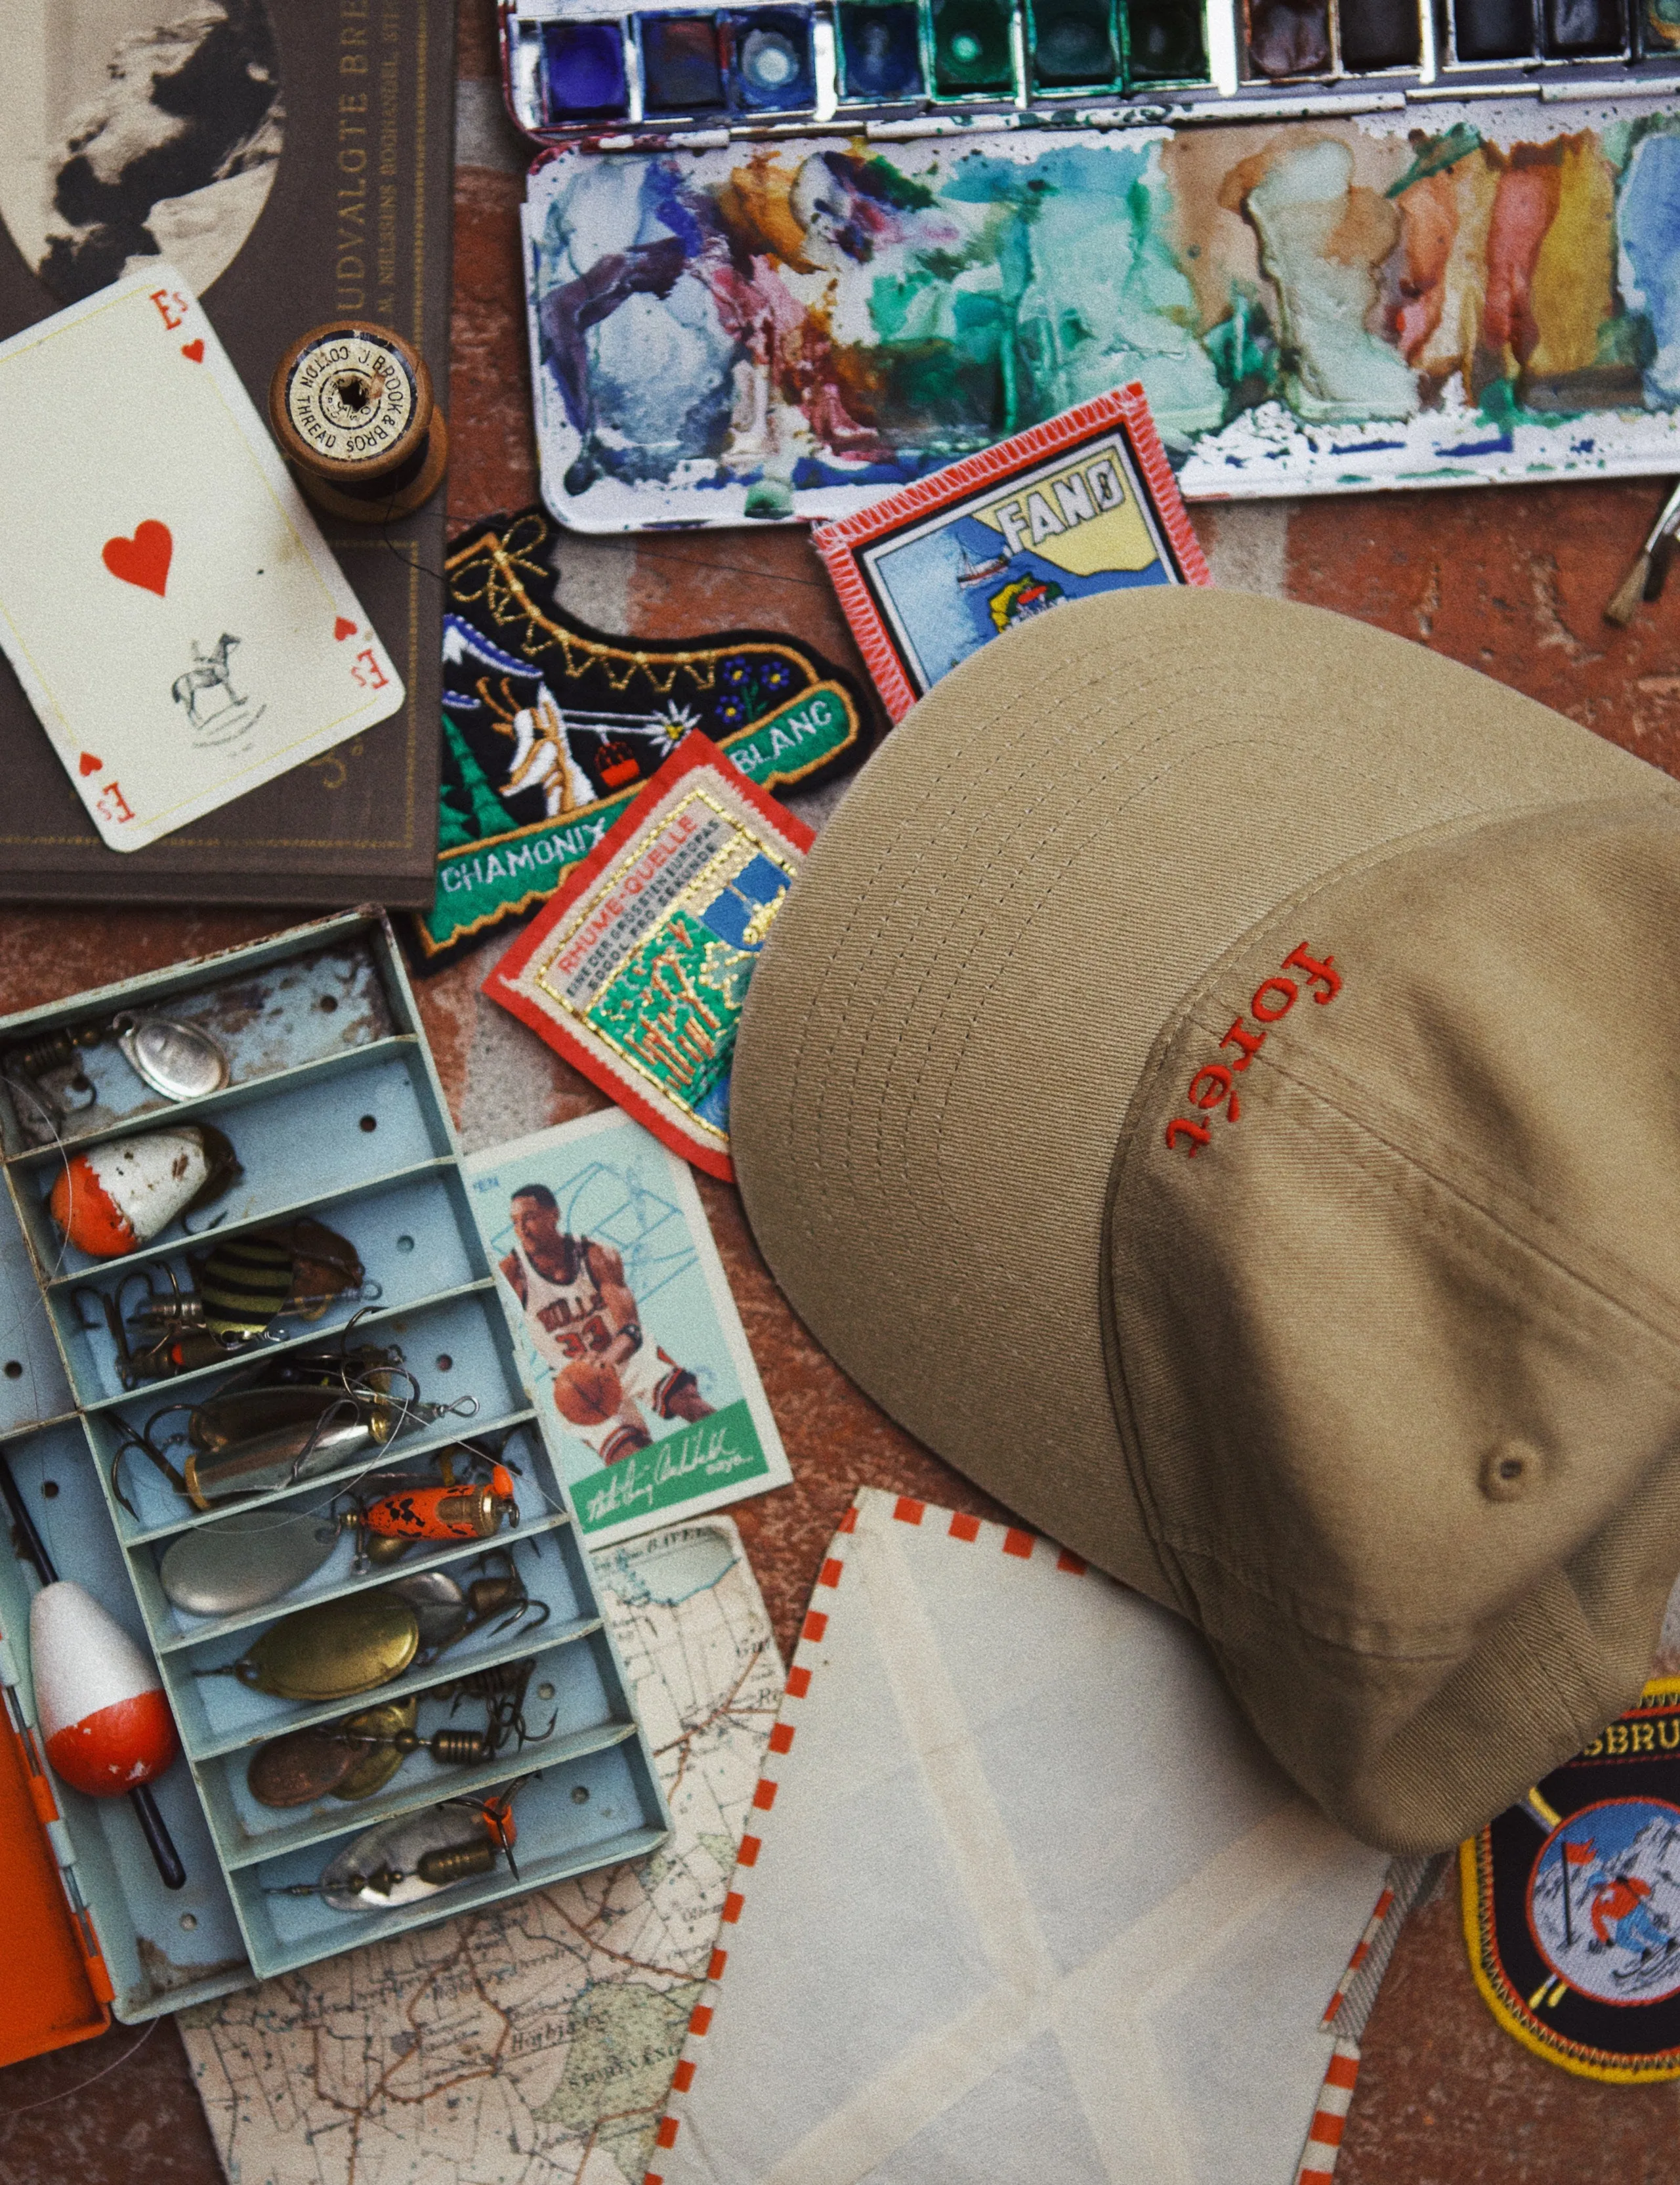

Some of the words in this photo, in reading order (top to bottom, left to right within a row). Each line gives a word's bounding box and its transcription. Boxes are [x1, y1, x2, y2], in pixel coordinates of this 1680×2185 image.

[297, 395, 336, 449] THREAD
[440, 816, 606, 893] CHAMONIX
[728, 700, 832, 774] BLANC
[555, 1315, 612, 1358] 33
